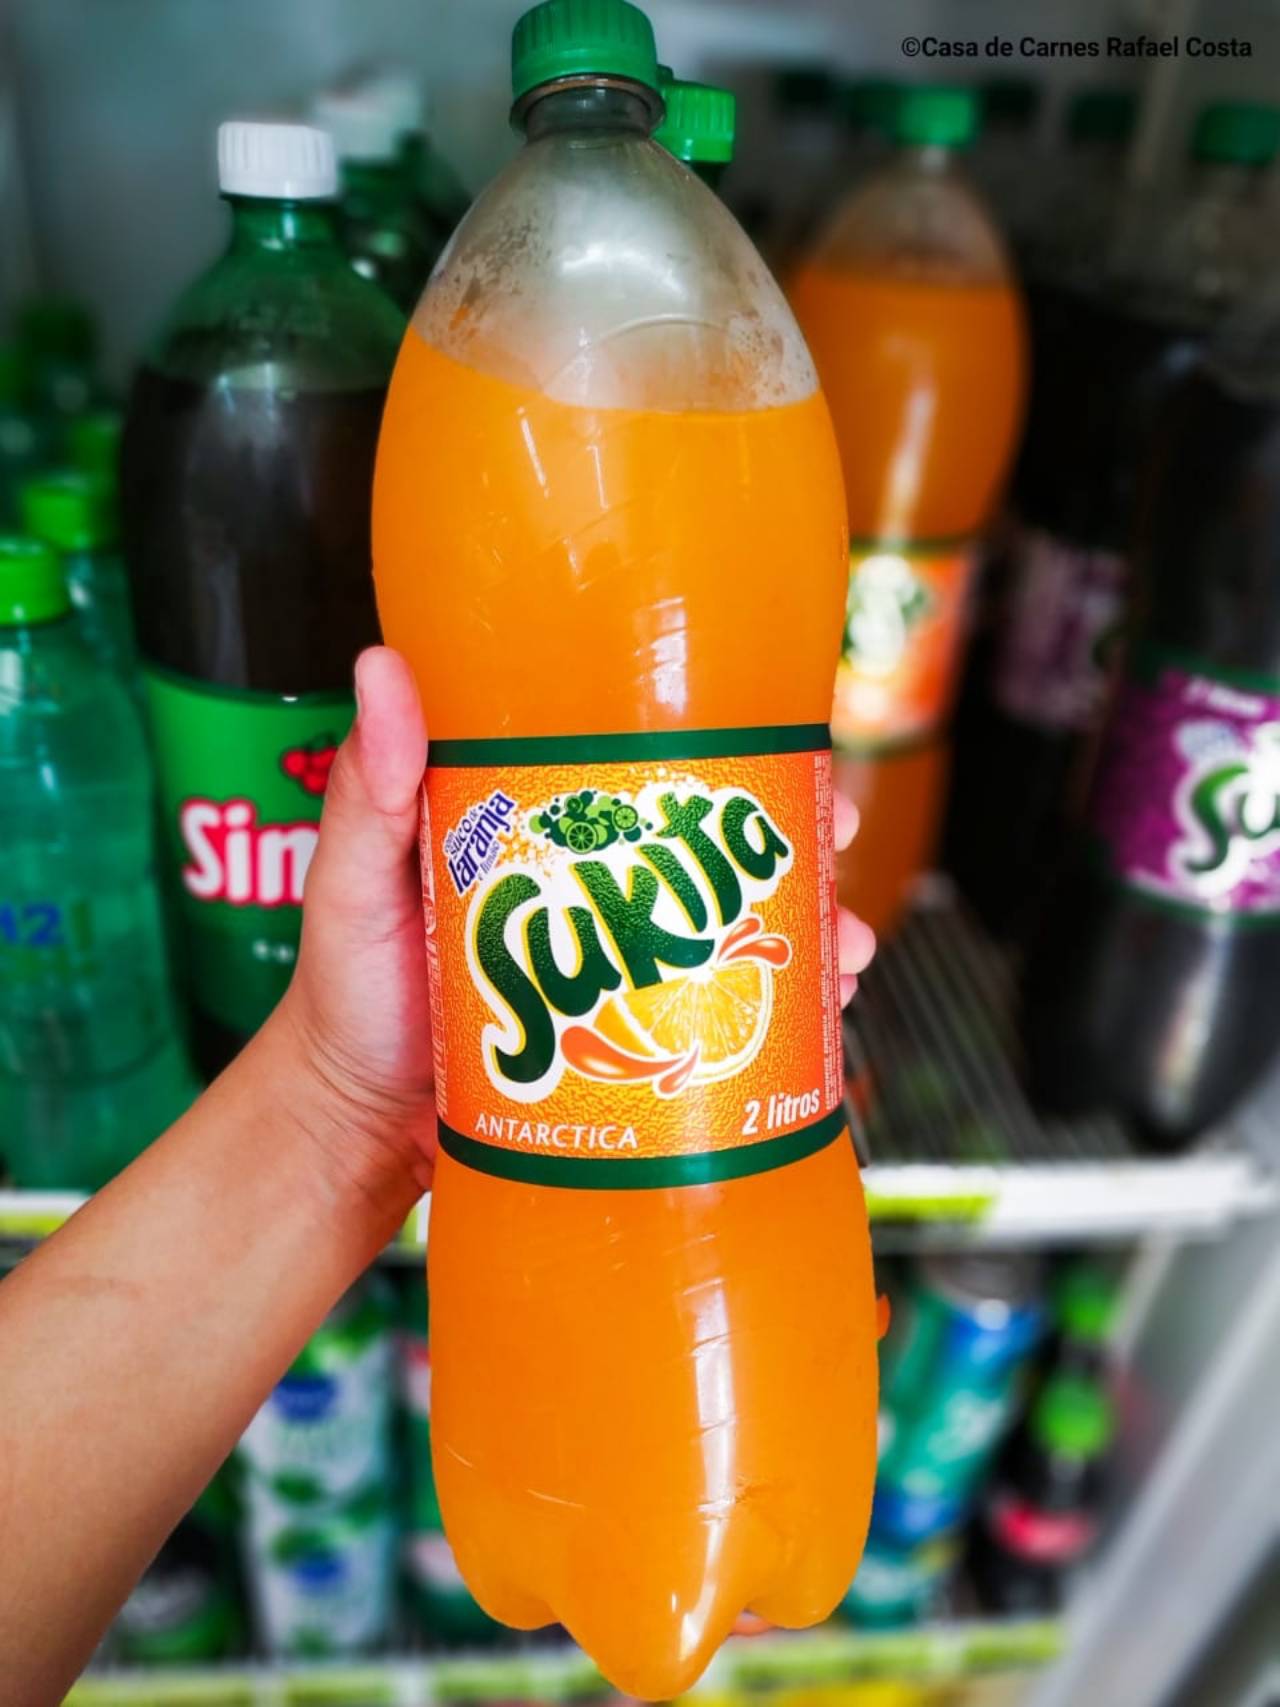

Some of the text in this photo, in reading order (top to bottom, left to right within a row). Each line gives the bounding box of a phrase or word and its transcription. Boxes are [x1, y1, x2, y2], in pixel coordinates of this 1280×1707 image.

[448, 791, 515, 894] laranja
[450, 818, 473, 860] suco
[473, 790, 790, 1085] Sukita
[475, 1113, 639, 1150] ANTARCTICA
[742, 1086, 821, 1136] 2 litros
